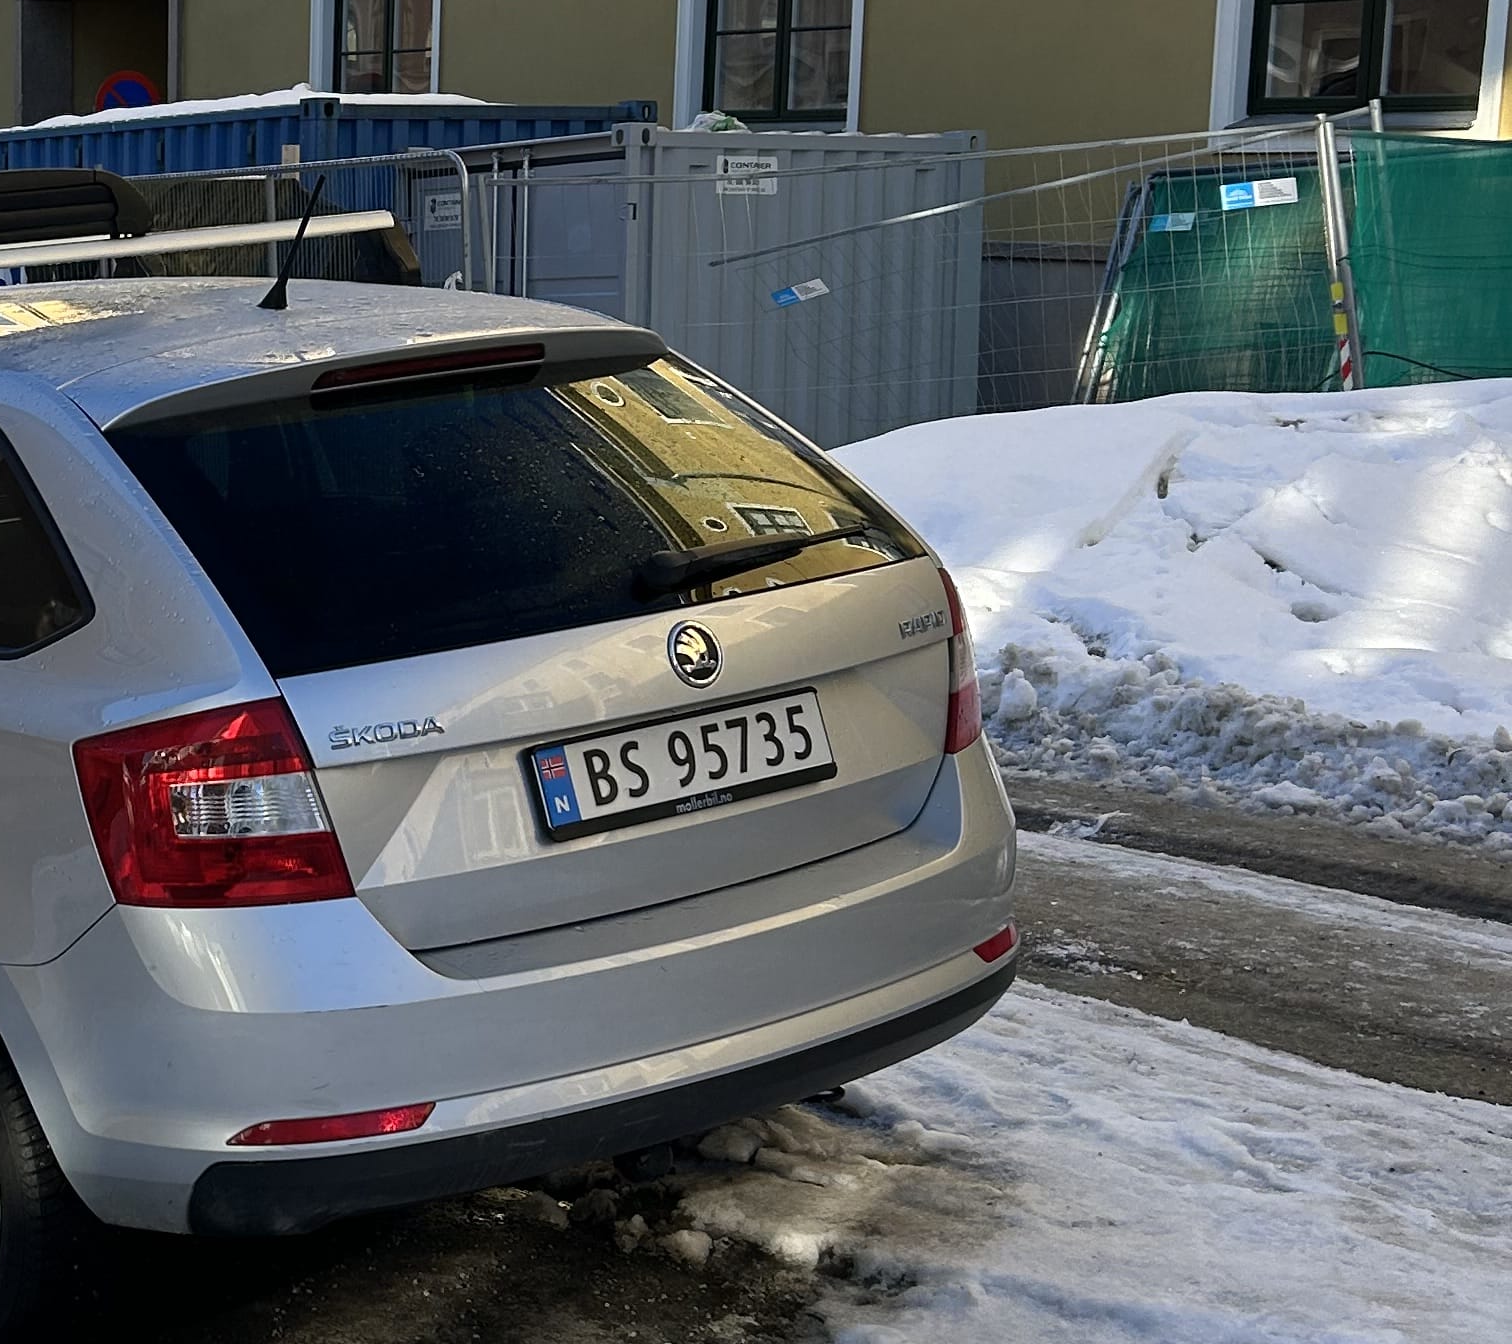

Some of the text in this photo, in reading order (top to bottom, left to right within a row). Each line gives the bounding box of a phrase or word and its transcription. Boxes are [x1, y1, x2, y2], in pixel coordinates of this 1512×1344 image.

[898, 609, 948, 641] RAPID
[328, 715, 445, 751] ŠKODA
[582, 703, 813, 807] BS 95735
[554, 794, 570, 814] N
